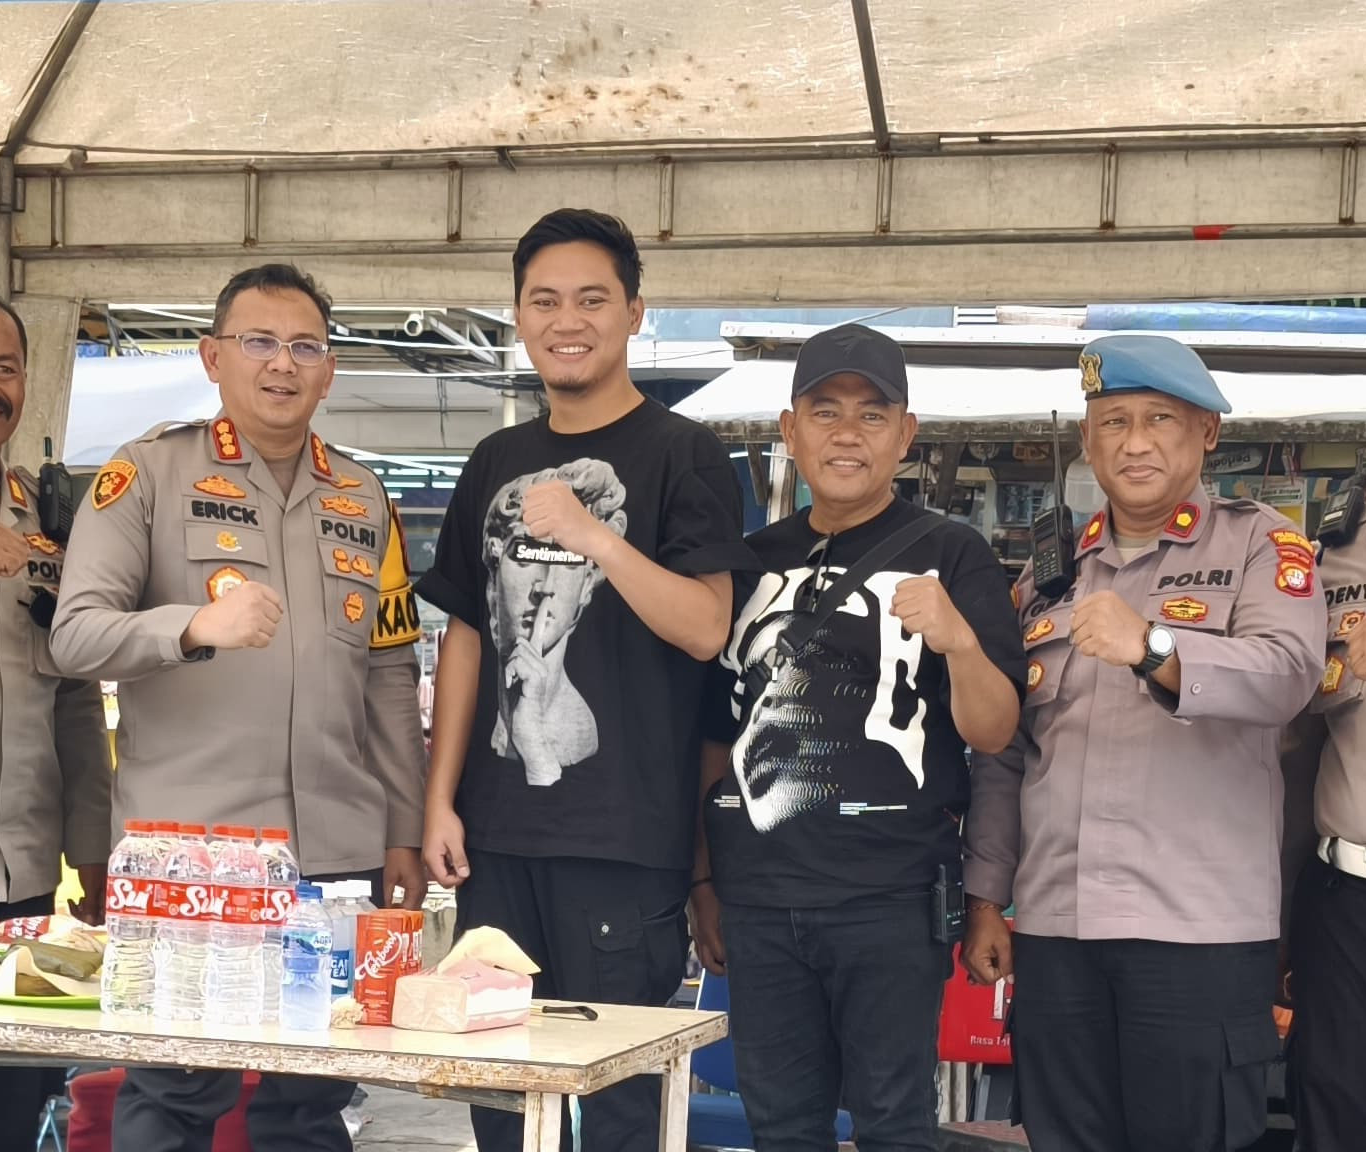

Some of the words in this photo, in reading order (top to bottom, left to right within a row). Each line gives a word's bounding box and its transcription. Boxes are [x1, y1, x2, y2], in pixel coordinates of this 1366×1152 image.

[191, 500, 259, 526] ERICK
[320, 519, 376, 548] POLRI
[1157, 569, 1233, 590] POLRI
